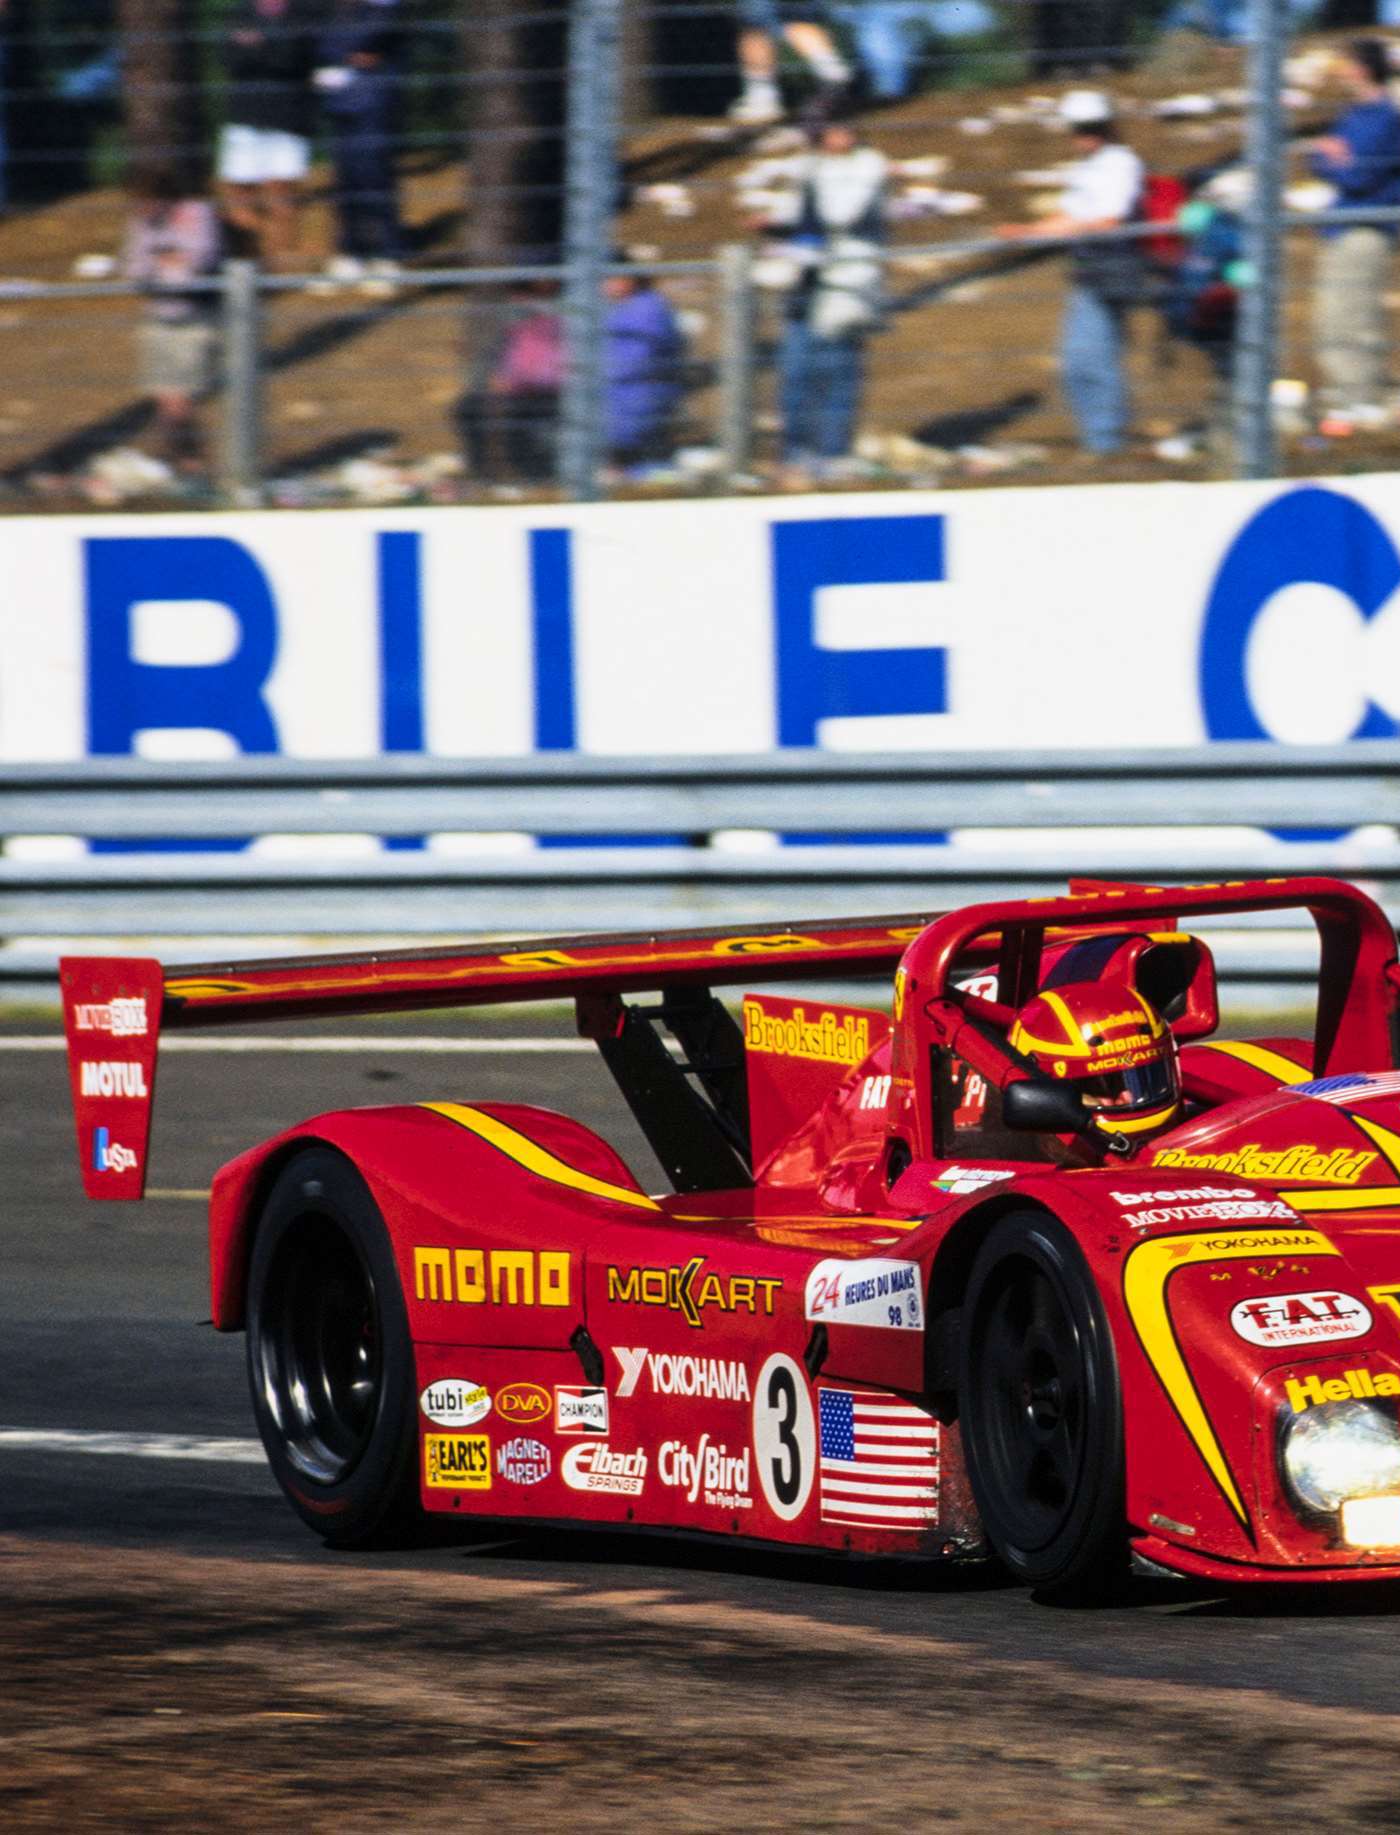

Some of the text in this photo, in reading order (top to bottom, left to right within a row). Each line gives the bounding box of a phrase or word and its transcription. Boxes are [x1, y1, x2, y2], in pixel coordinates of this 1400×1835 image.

[745, 1002, 868, 1063] Brooksfield
[81, 1061, 148, 1097] MOTUL
[1153, 1145, 1379, 1184] Brooksfield
[1109, 1186, 1256, 1205] brembo
[1202, 1236, 1319, 1251] YOKOHAMA
[414, 1247, 785, 1328] momo MOKART
[811, 1266, 915, 1316] 24 HEURES DU MANS
[888, 1305, 903, 1327] 98
[1262, 1323, 1359, 1342] INTERNATIONAL
[648, 1353, 751, 1403] YOKOHAMA
[427, 1387, 463, 1410] tubi
[502, 1394, 546, 1412] DVA
[560, 1401, 604, 1419] CHAMPION
[769, 1366, 802, 1506] 3
[439, 1440, 487, 1472] EARL'S
[562, 1442, 648, 1482] Eibach
[586, 1477, 639, 1492] SPRINGS
